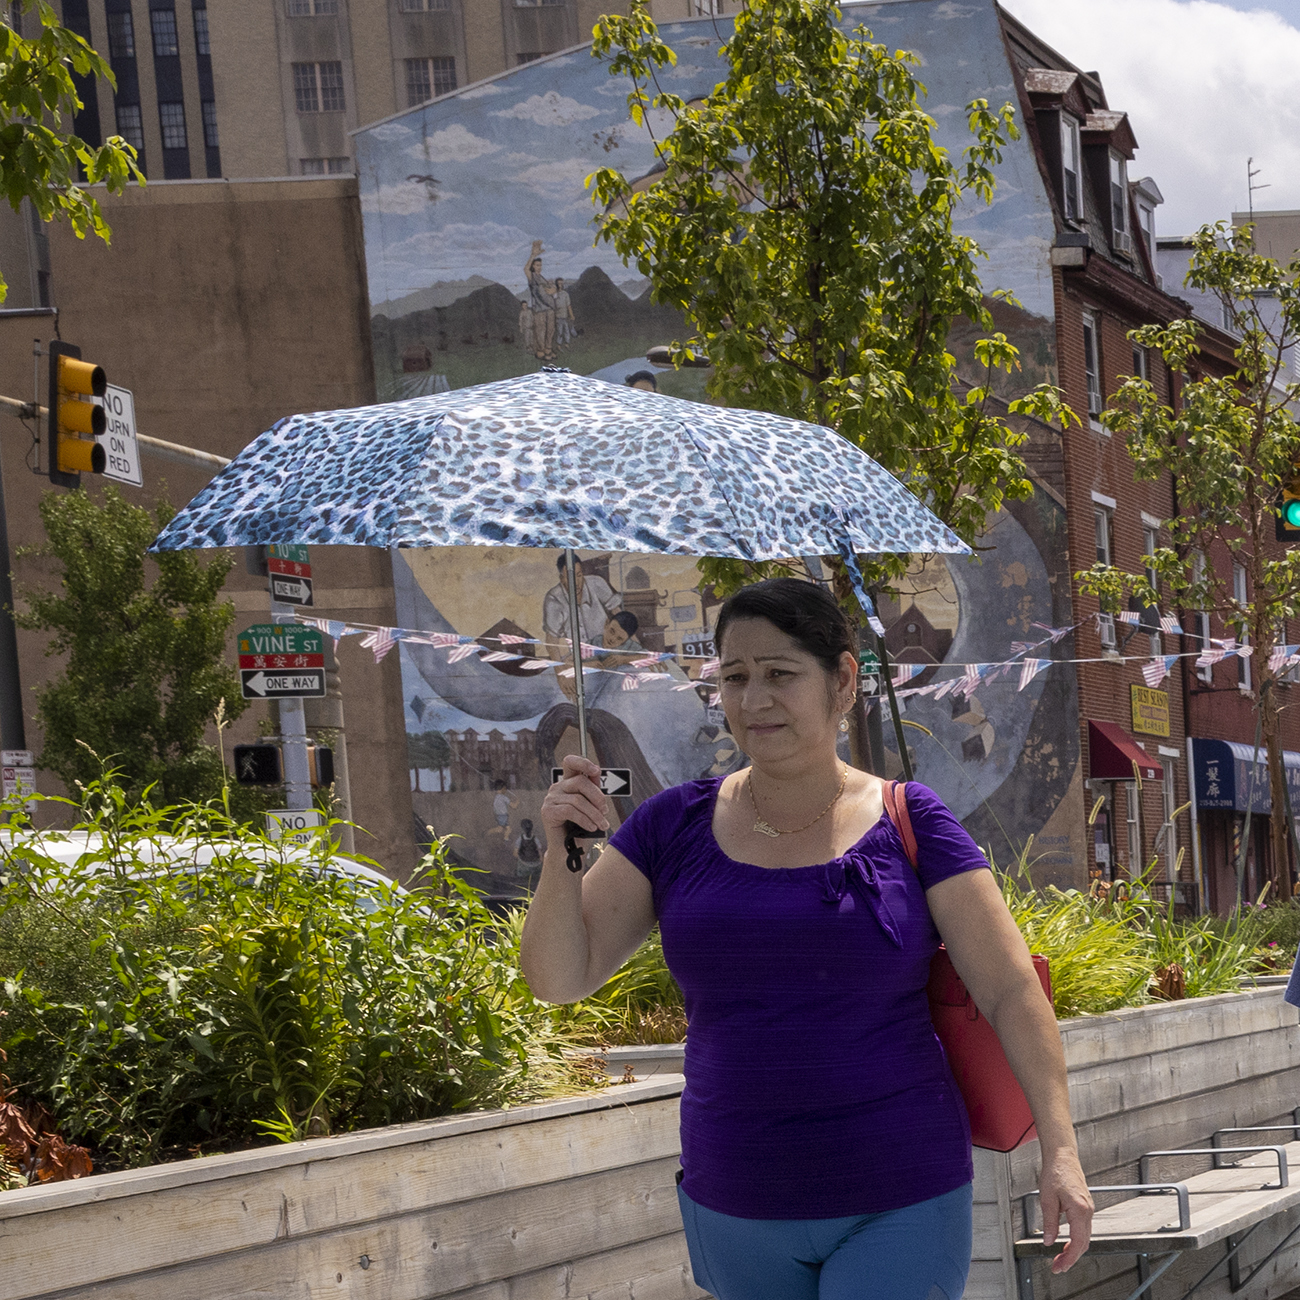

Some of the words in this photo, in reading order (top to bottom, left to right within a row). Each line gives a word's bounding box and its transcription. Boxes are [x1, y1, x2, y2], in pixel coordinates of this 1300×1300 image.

[102, 393, 123, 416] NO
[106, 417, 130, 438] URN
[110, 437, 126, 455] ON
[109, 455, 131, 474] RED
[276, 583, 289, 595] ONE
[285, 626, 303, 634] 1000
[252, 635, 296, 652] VINE
[303, 640, 318, 651] ST
[686, 641, 716, 656] 913
[266, 677, 289, 689] ONE
[291, 676, 316, 689] WAY
[281, 816, 306, 830] NO
